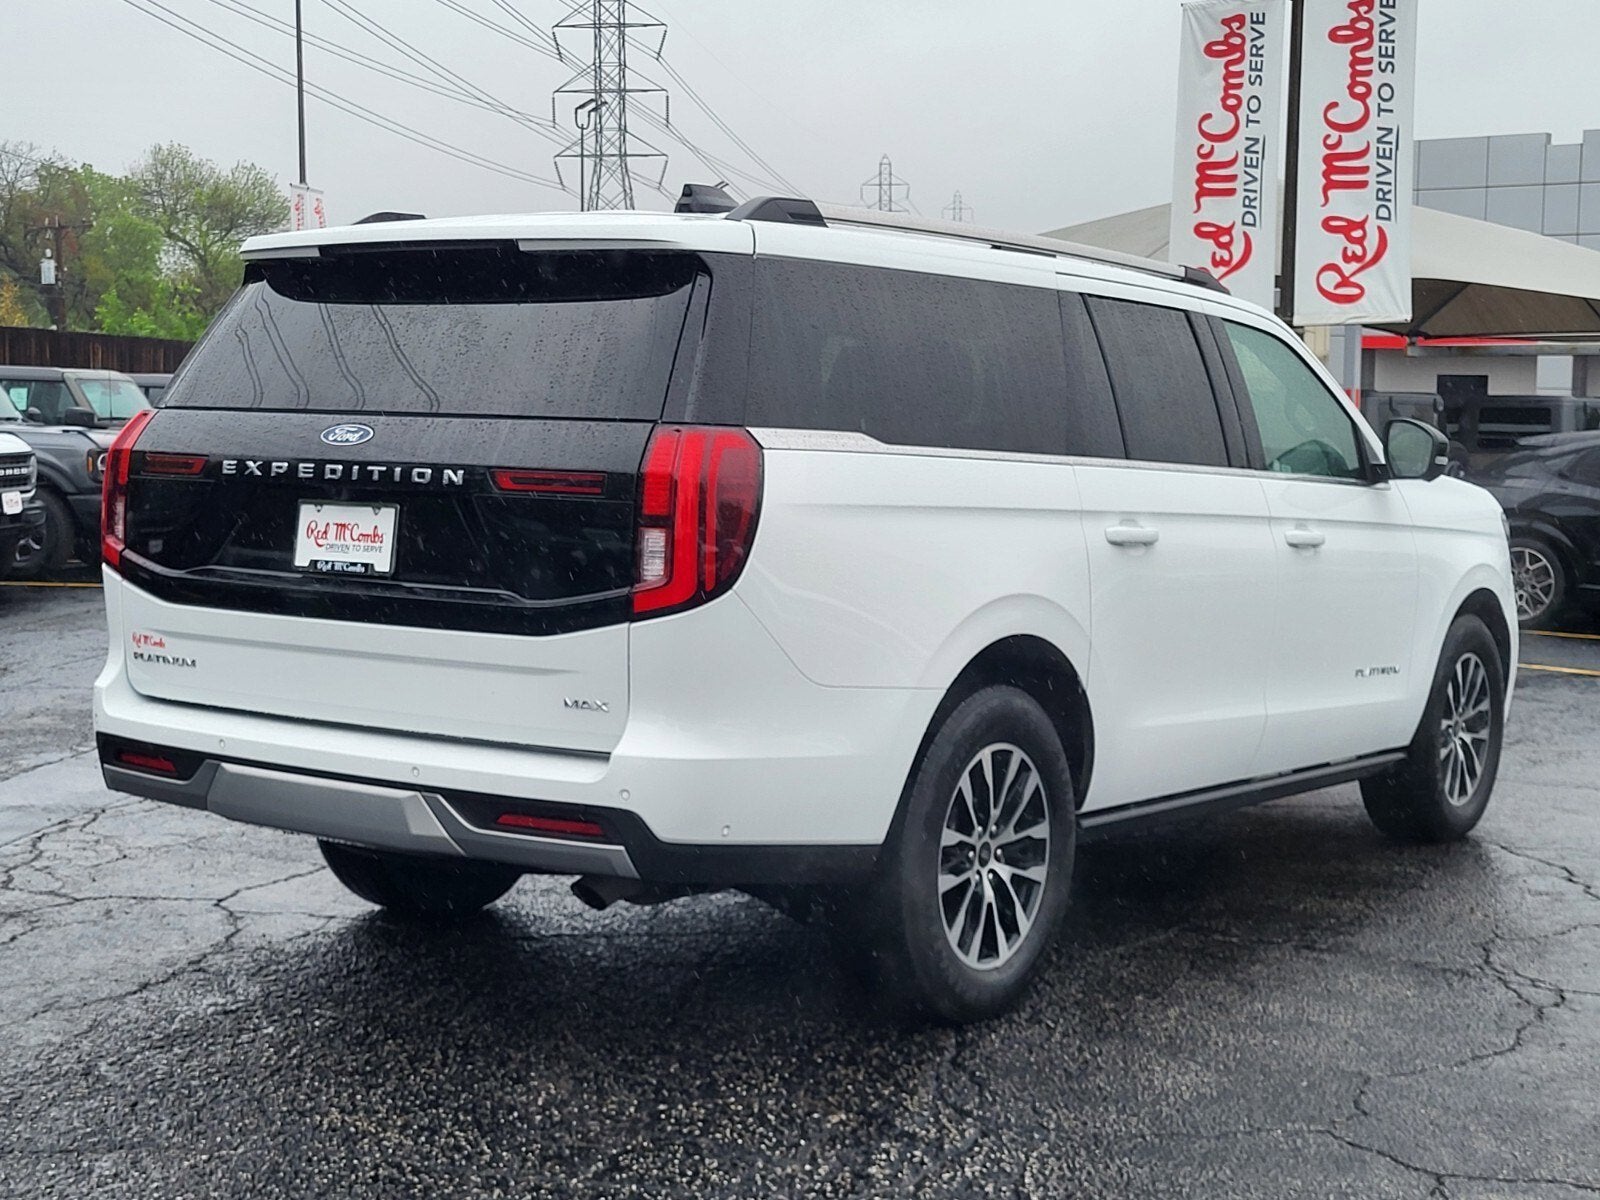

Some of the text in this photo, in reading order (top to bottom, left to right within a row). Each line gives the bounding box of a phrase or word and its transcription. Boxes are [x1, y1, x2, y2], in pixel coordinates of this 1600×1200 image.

[1193, 13, 1246, 214] McCombs
[1241, 11, 1266, 228] DRIVEN TO SERVE
[1375, 0, 1396, 222] DRIVEN TO SERVE
[1316, 0, 1388, 305] Red McCombs
[222, 459, 465, 486] EXPEDITION
[306, 519, 384, 548] Red McCombs
[325, 543, 383, 554] DRIVEN TO SERVE
[133, 651, 197, 668] PLATINUM
[563, 697, 610, 713] MAX
